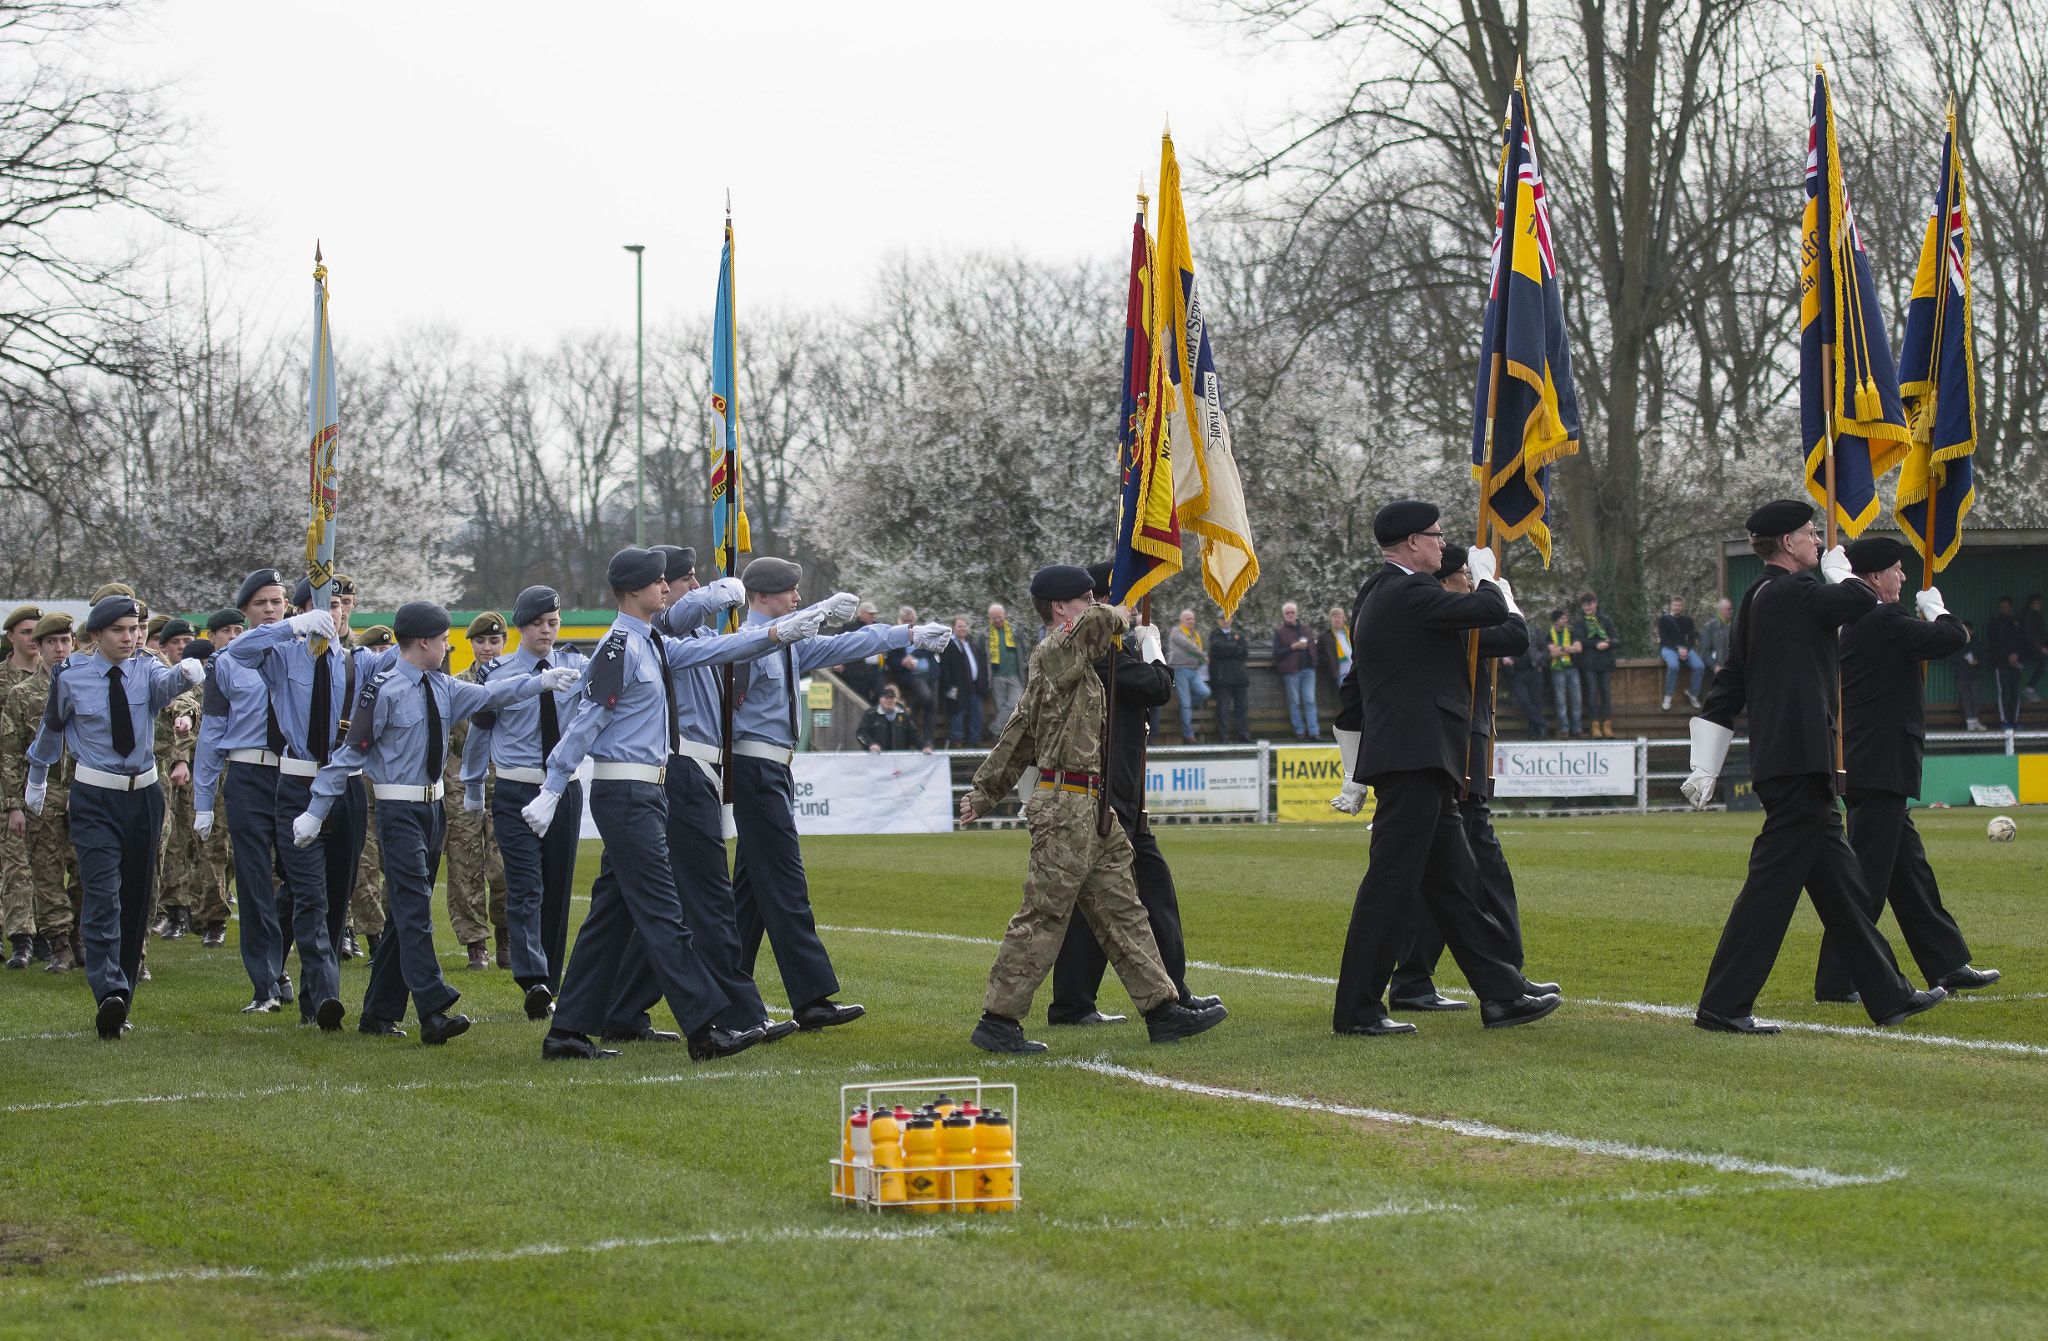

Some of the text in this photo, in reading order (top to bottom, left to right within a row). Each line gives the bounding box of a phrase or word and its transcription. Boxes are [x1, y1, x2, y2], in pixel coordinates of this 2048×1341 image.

[1207, 374, 1221, 439] ROYAL CORPS
[1511, 751, 1610, 776] Satchells
[1172, 767, 1206, 792] Hill
[793, 798, 830, 817] Fund
